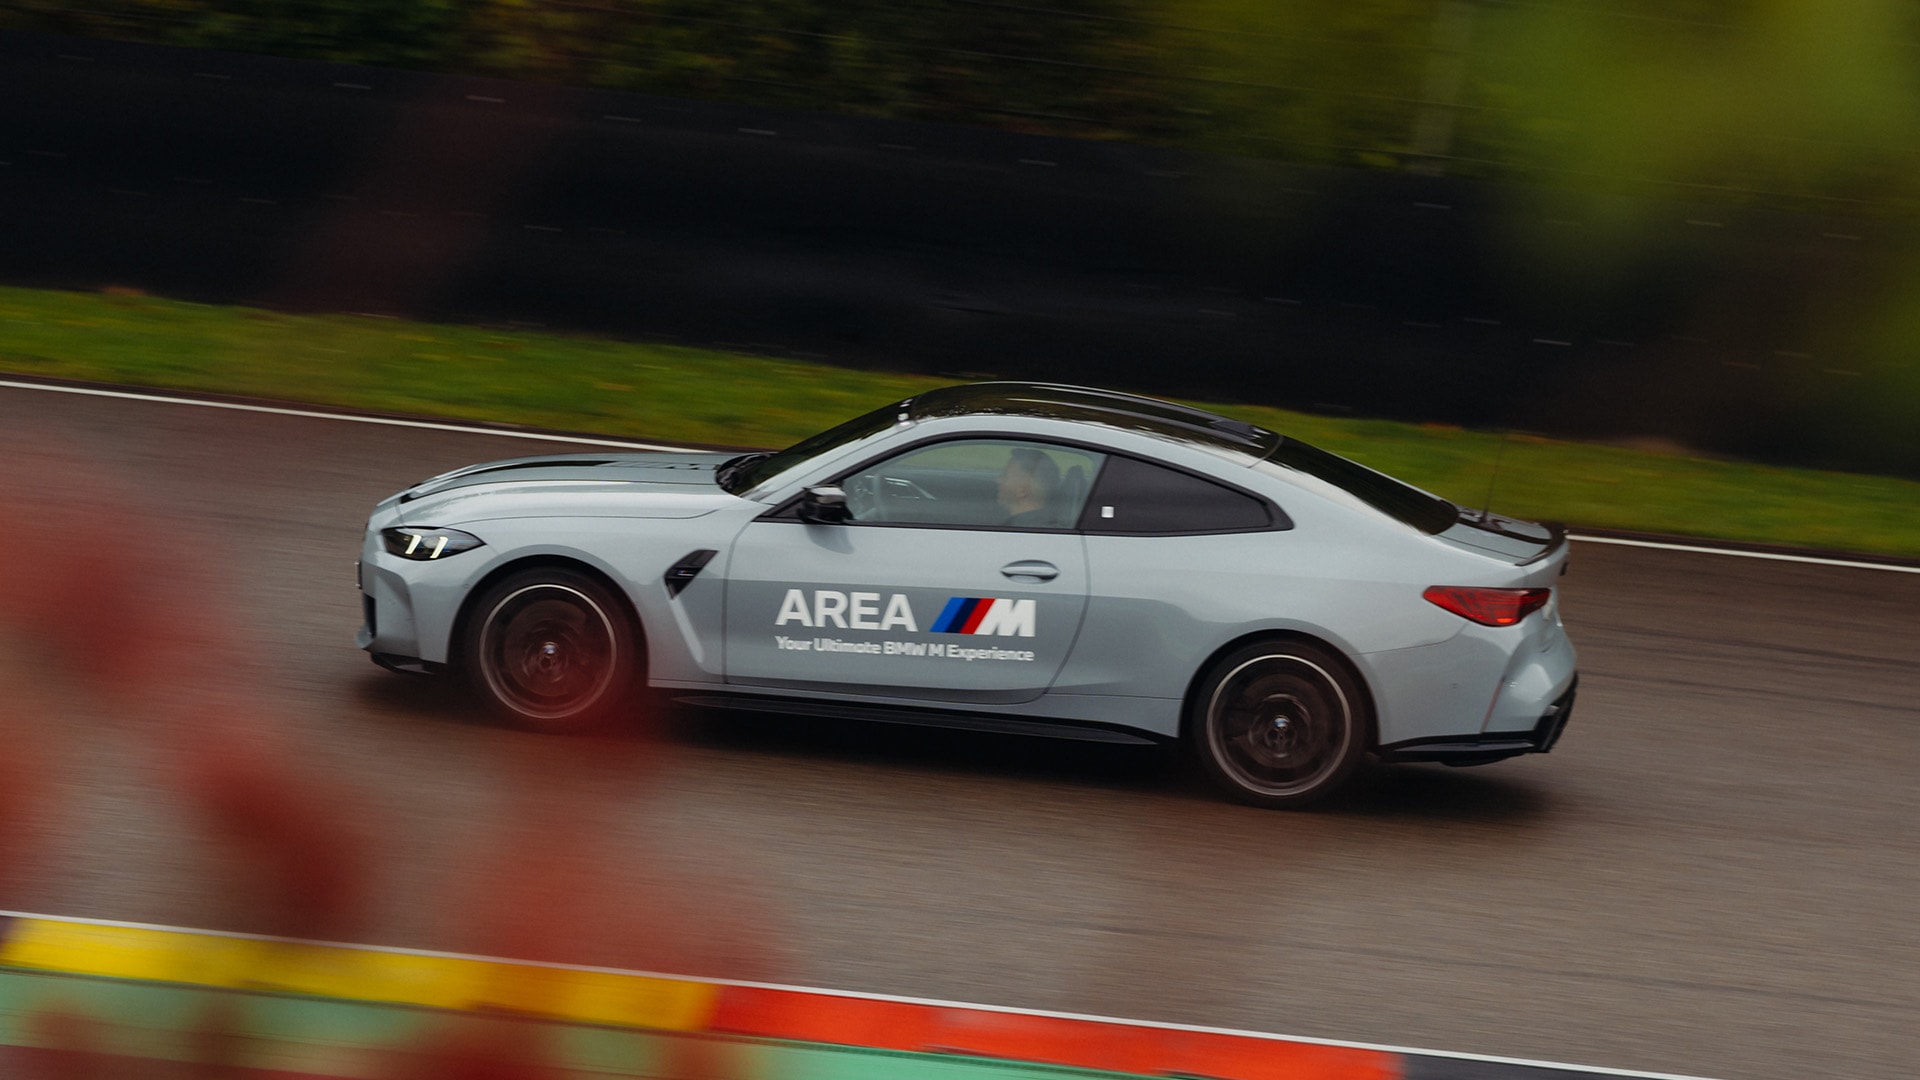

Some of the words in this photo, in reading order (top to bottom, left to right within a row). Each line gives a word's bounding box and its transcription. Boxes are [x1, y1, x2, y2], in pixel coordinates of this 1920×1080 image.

[775, 588, 919, 632] AREA
[973, 598, 1036, 637] M
[775, 635, 812, 651] Your
[814, 638, 882, 654] Ultimate
[883, 641, 927, 656] BMW
[928, 643, 945, 657] M
[947, 644, 1035, 661] Experience
